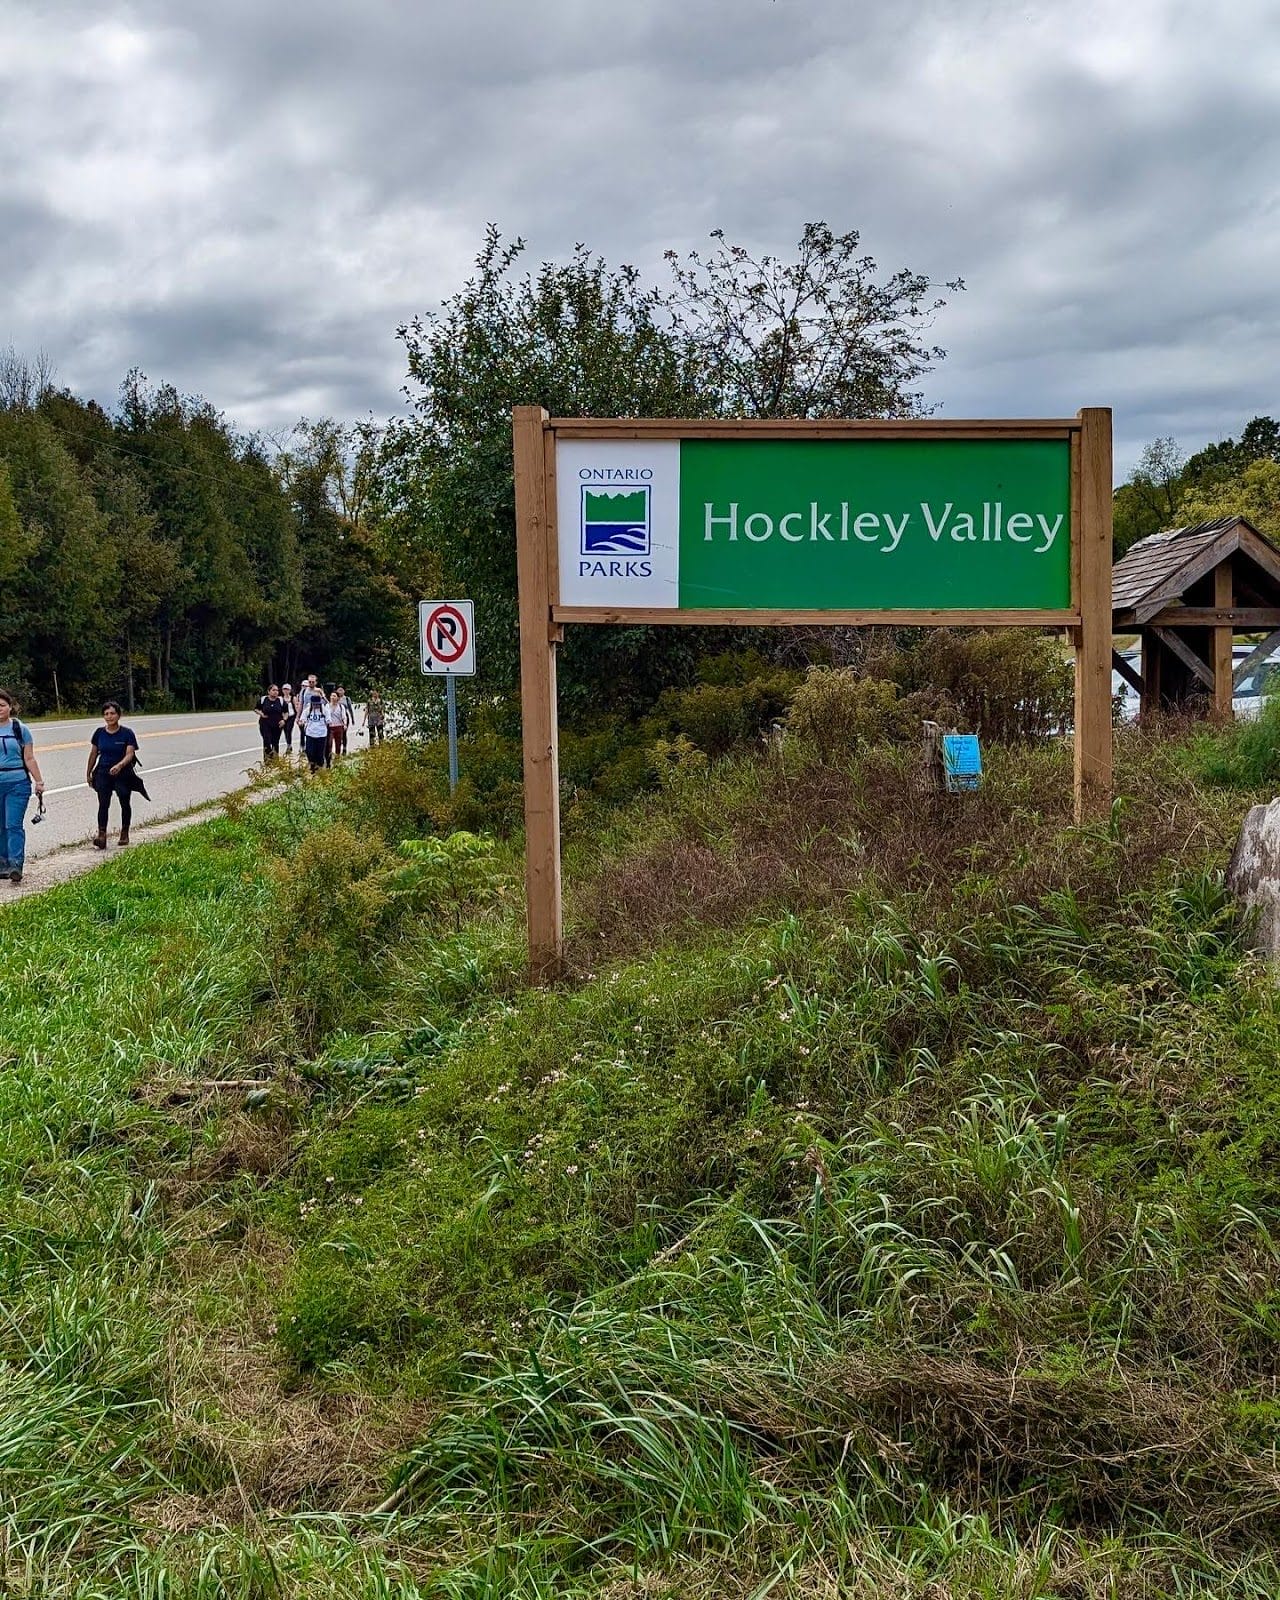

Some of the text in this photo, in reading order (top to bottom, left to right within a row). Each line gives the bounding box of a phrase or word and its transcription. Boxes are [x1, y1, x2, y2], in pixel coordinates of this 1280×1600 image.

[578, 468, 654, 480] ONTARIO
[703, 502, 1064, 553] Hockley Valley
[578, 561, 653, 578] PARKS
[436, 617, 457, 650] P
